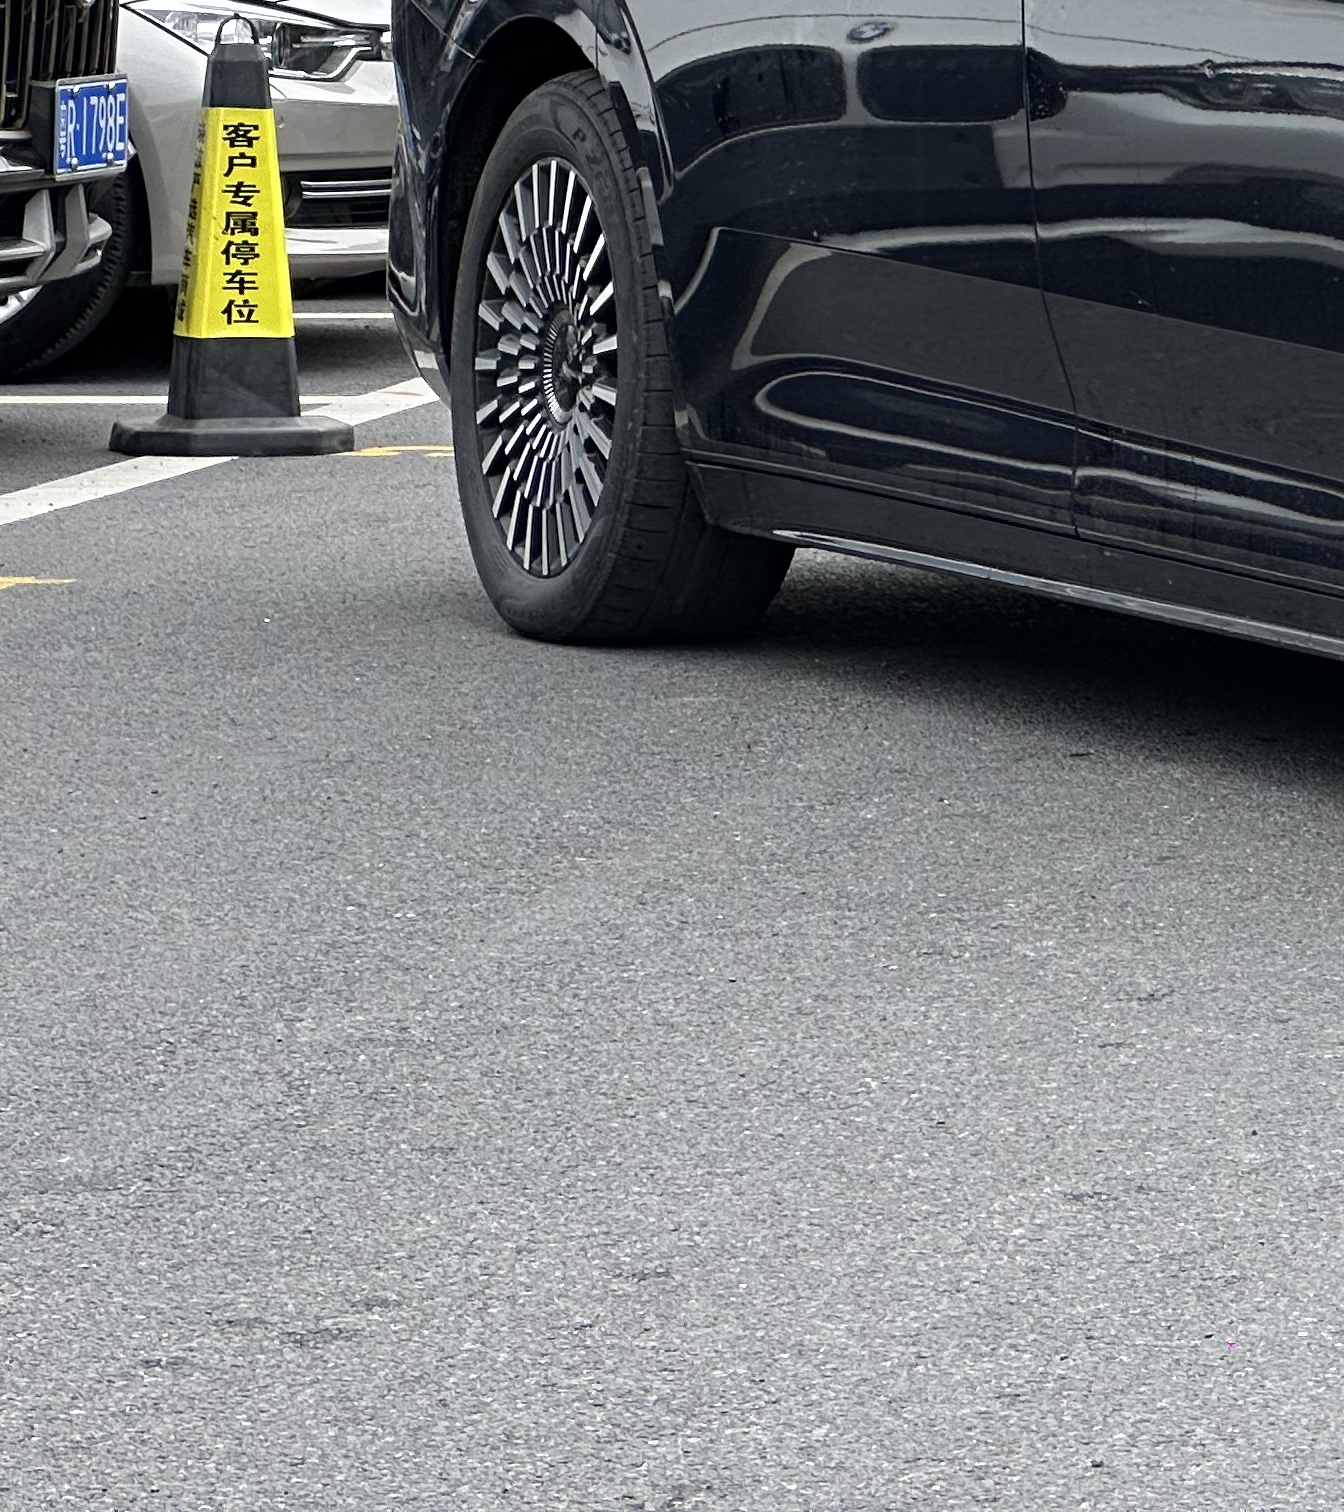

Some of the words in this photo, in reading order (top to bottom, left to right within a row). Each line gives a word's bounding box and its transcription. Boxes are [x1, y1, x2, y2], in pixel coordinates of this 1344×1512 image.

[221, 122, 261, 325] 客户专属停车位
